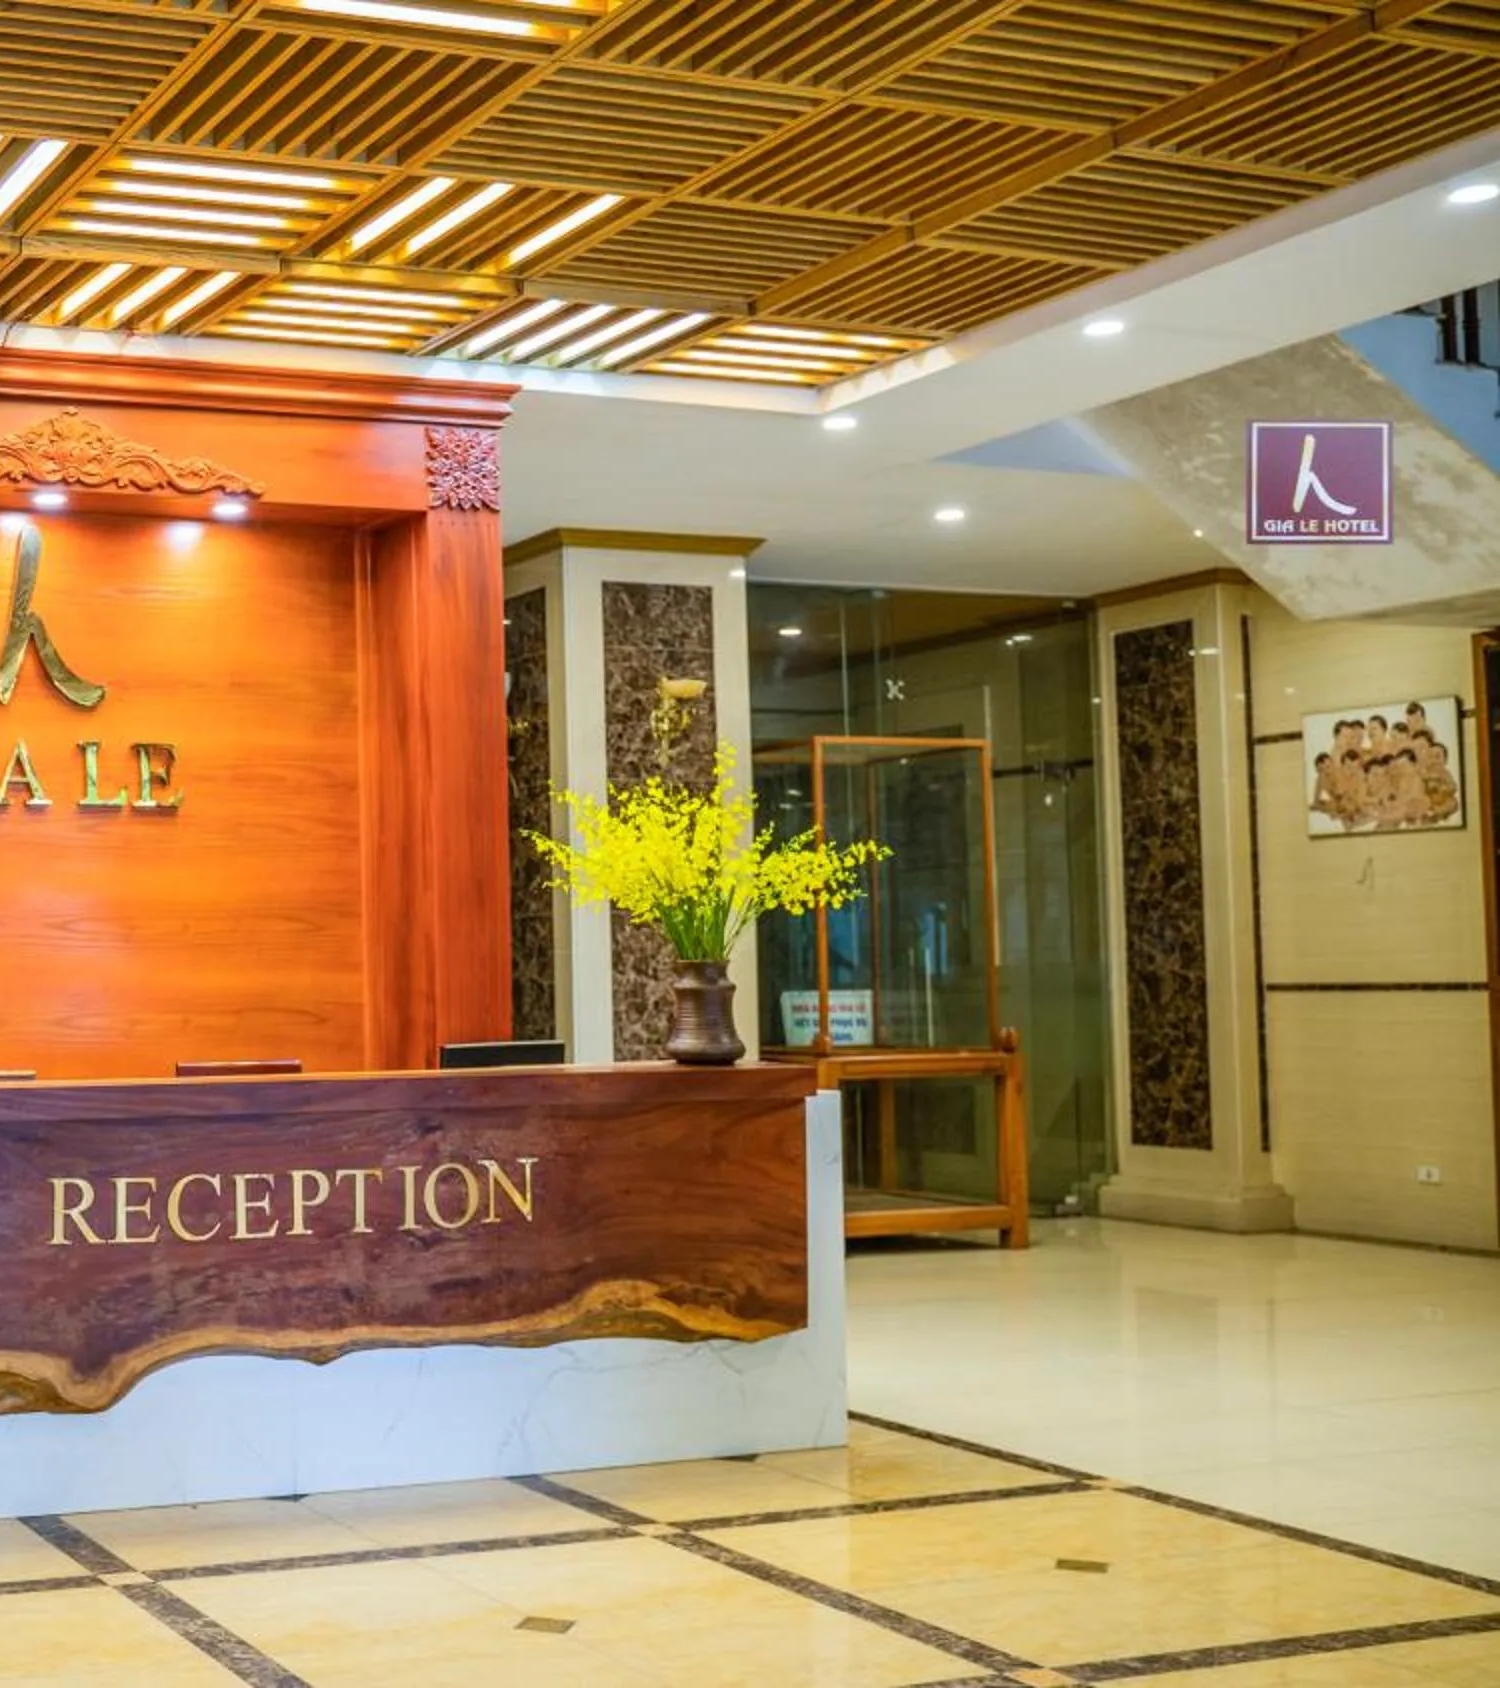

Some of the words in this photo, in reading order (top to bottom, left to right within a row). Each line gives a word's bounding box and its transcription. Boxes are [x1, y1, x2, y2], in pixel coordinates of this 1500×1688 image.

[1263, 520, 1294, 533] GIA
[1301, 520, 1319, 532] LE
[1324, 519, 1380, 533] HOTEL
[76, 740, 184, 812] LE
[46, 1156, 540, 1246] RECEPTION
